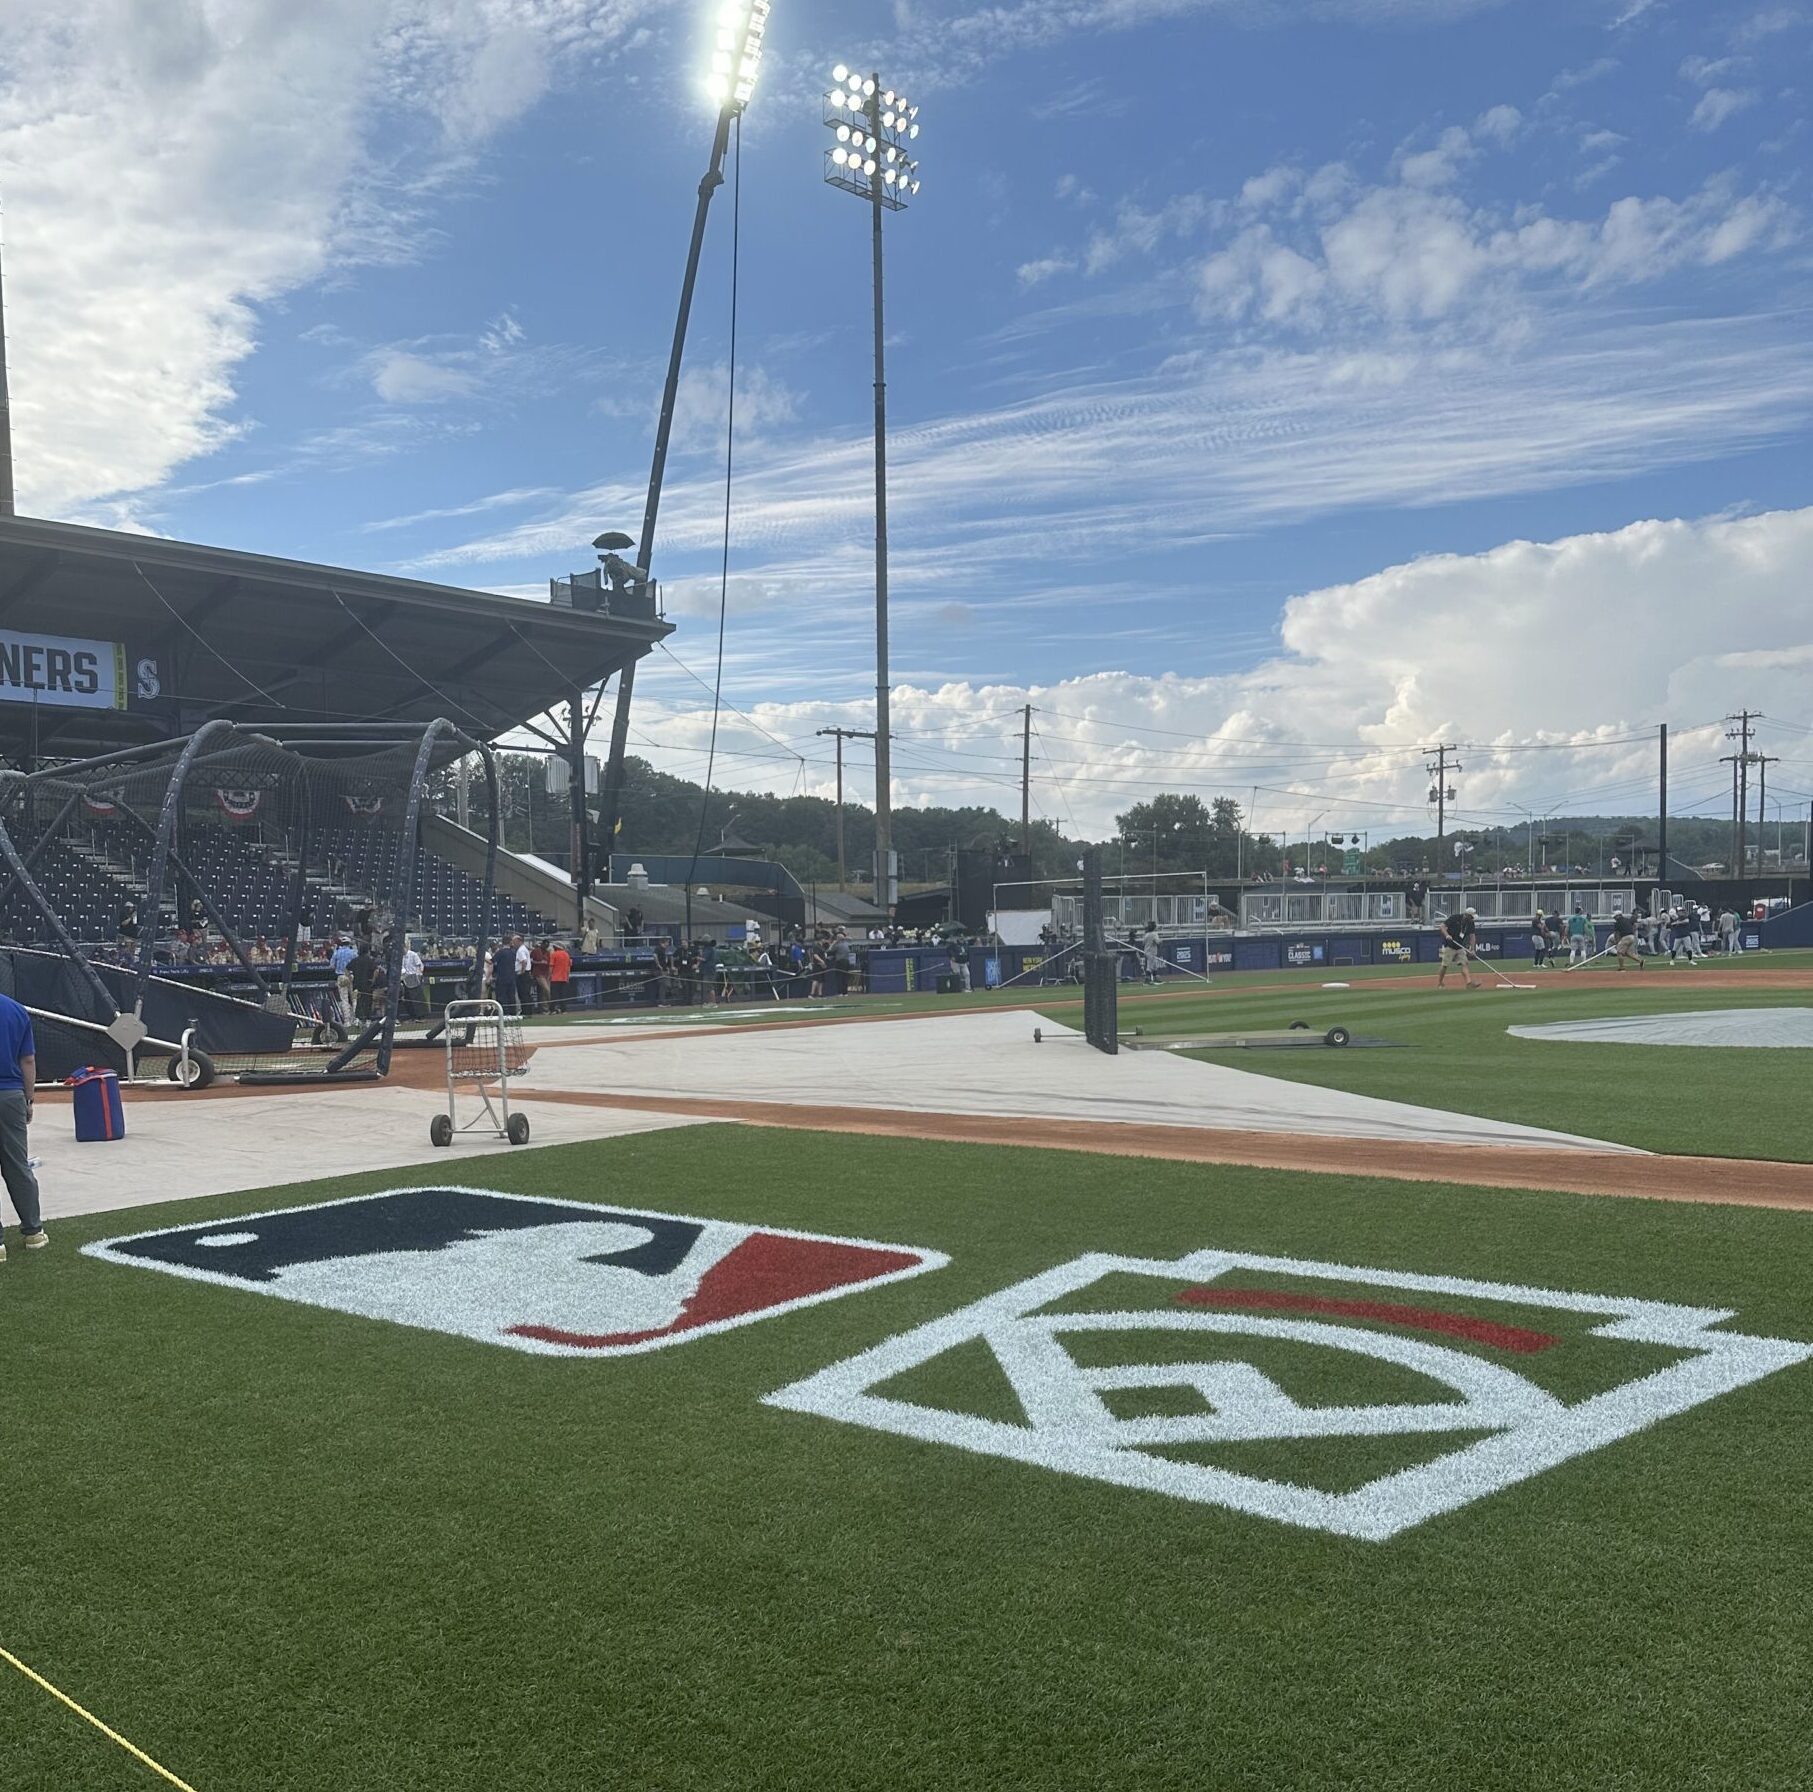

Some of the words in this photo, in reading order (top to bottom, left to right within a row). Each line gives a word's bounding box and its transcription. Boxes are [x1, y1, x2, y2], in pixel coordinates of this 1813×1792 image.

[0, 642, 99, 694] NERS
[1475, 943, 1491, 951] MLB
[1177, 950, 1191, 960] 2025
